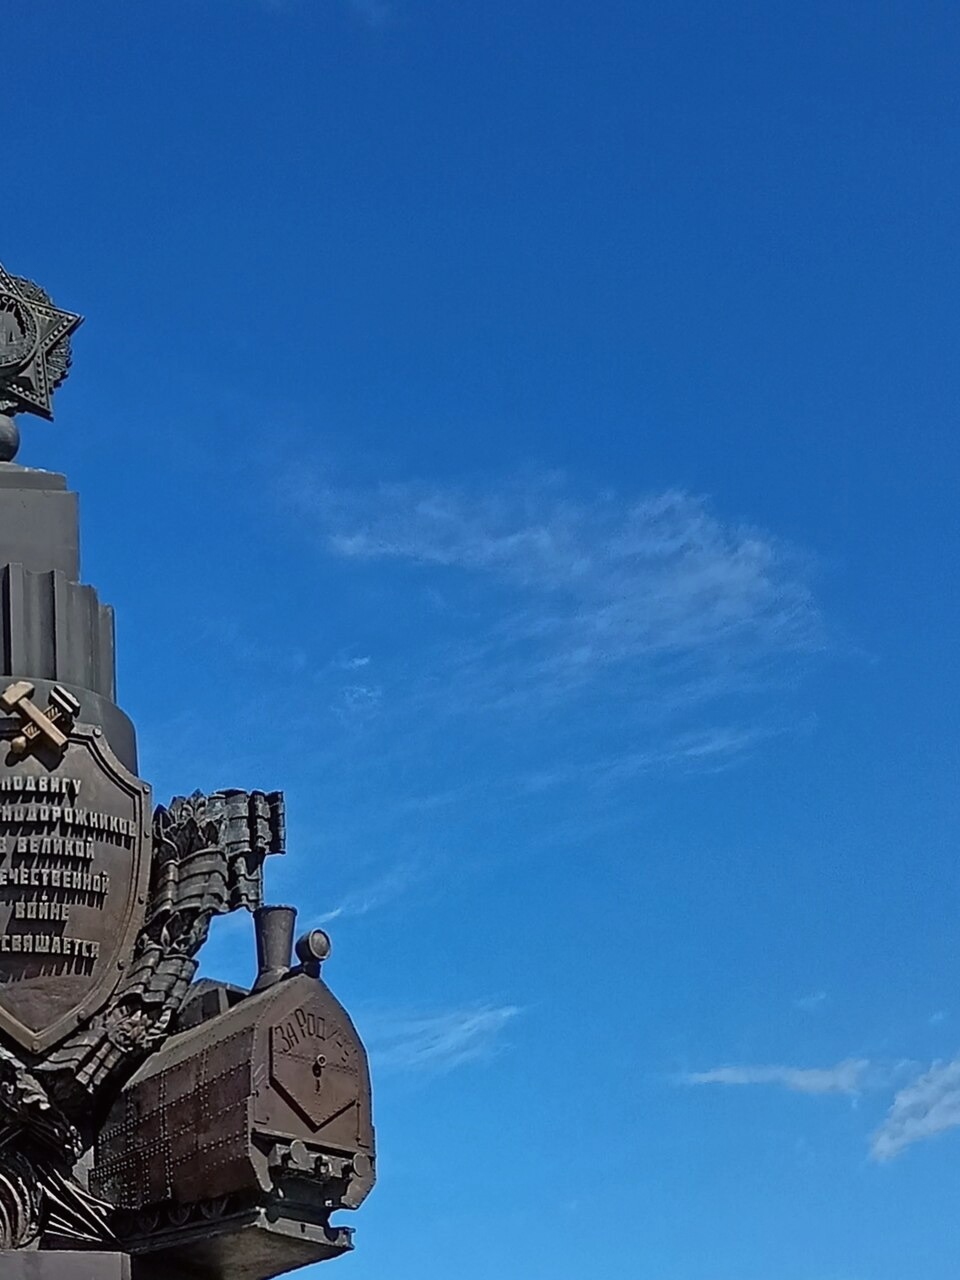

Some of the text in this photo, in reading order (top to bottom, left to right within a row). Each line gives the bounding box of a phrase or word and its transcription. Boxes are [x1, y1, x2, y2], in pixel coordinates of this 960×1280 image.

[1, 776, 81, 794] ПОДВИГУ
[17, 837, 95, 859] ВЕЛИКОЙ
[15, 895, 70, 920] ВОЙНЕ
